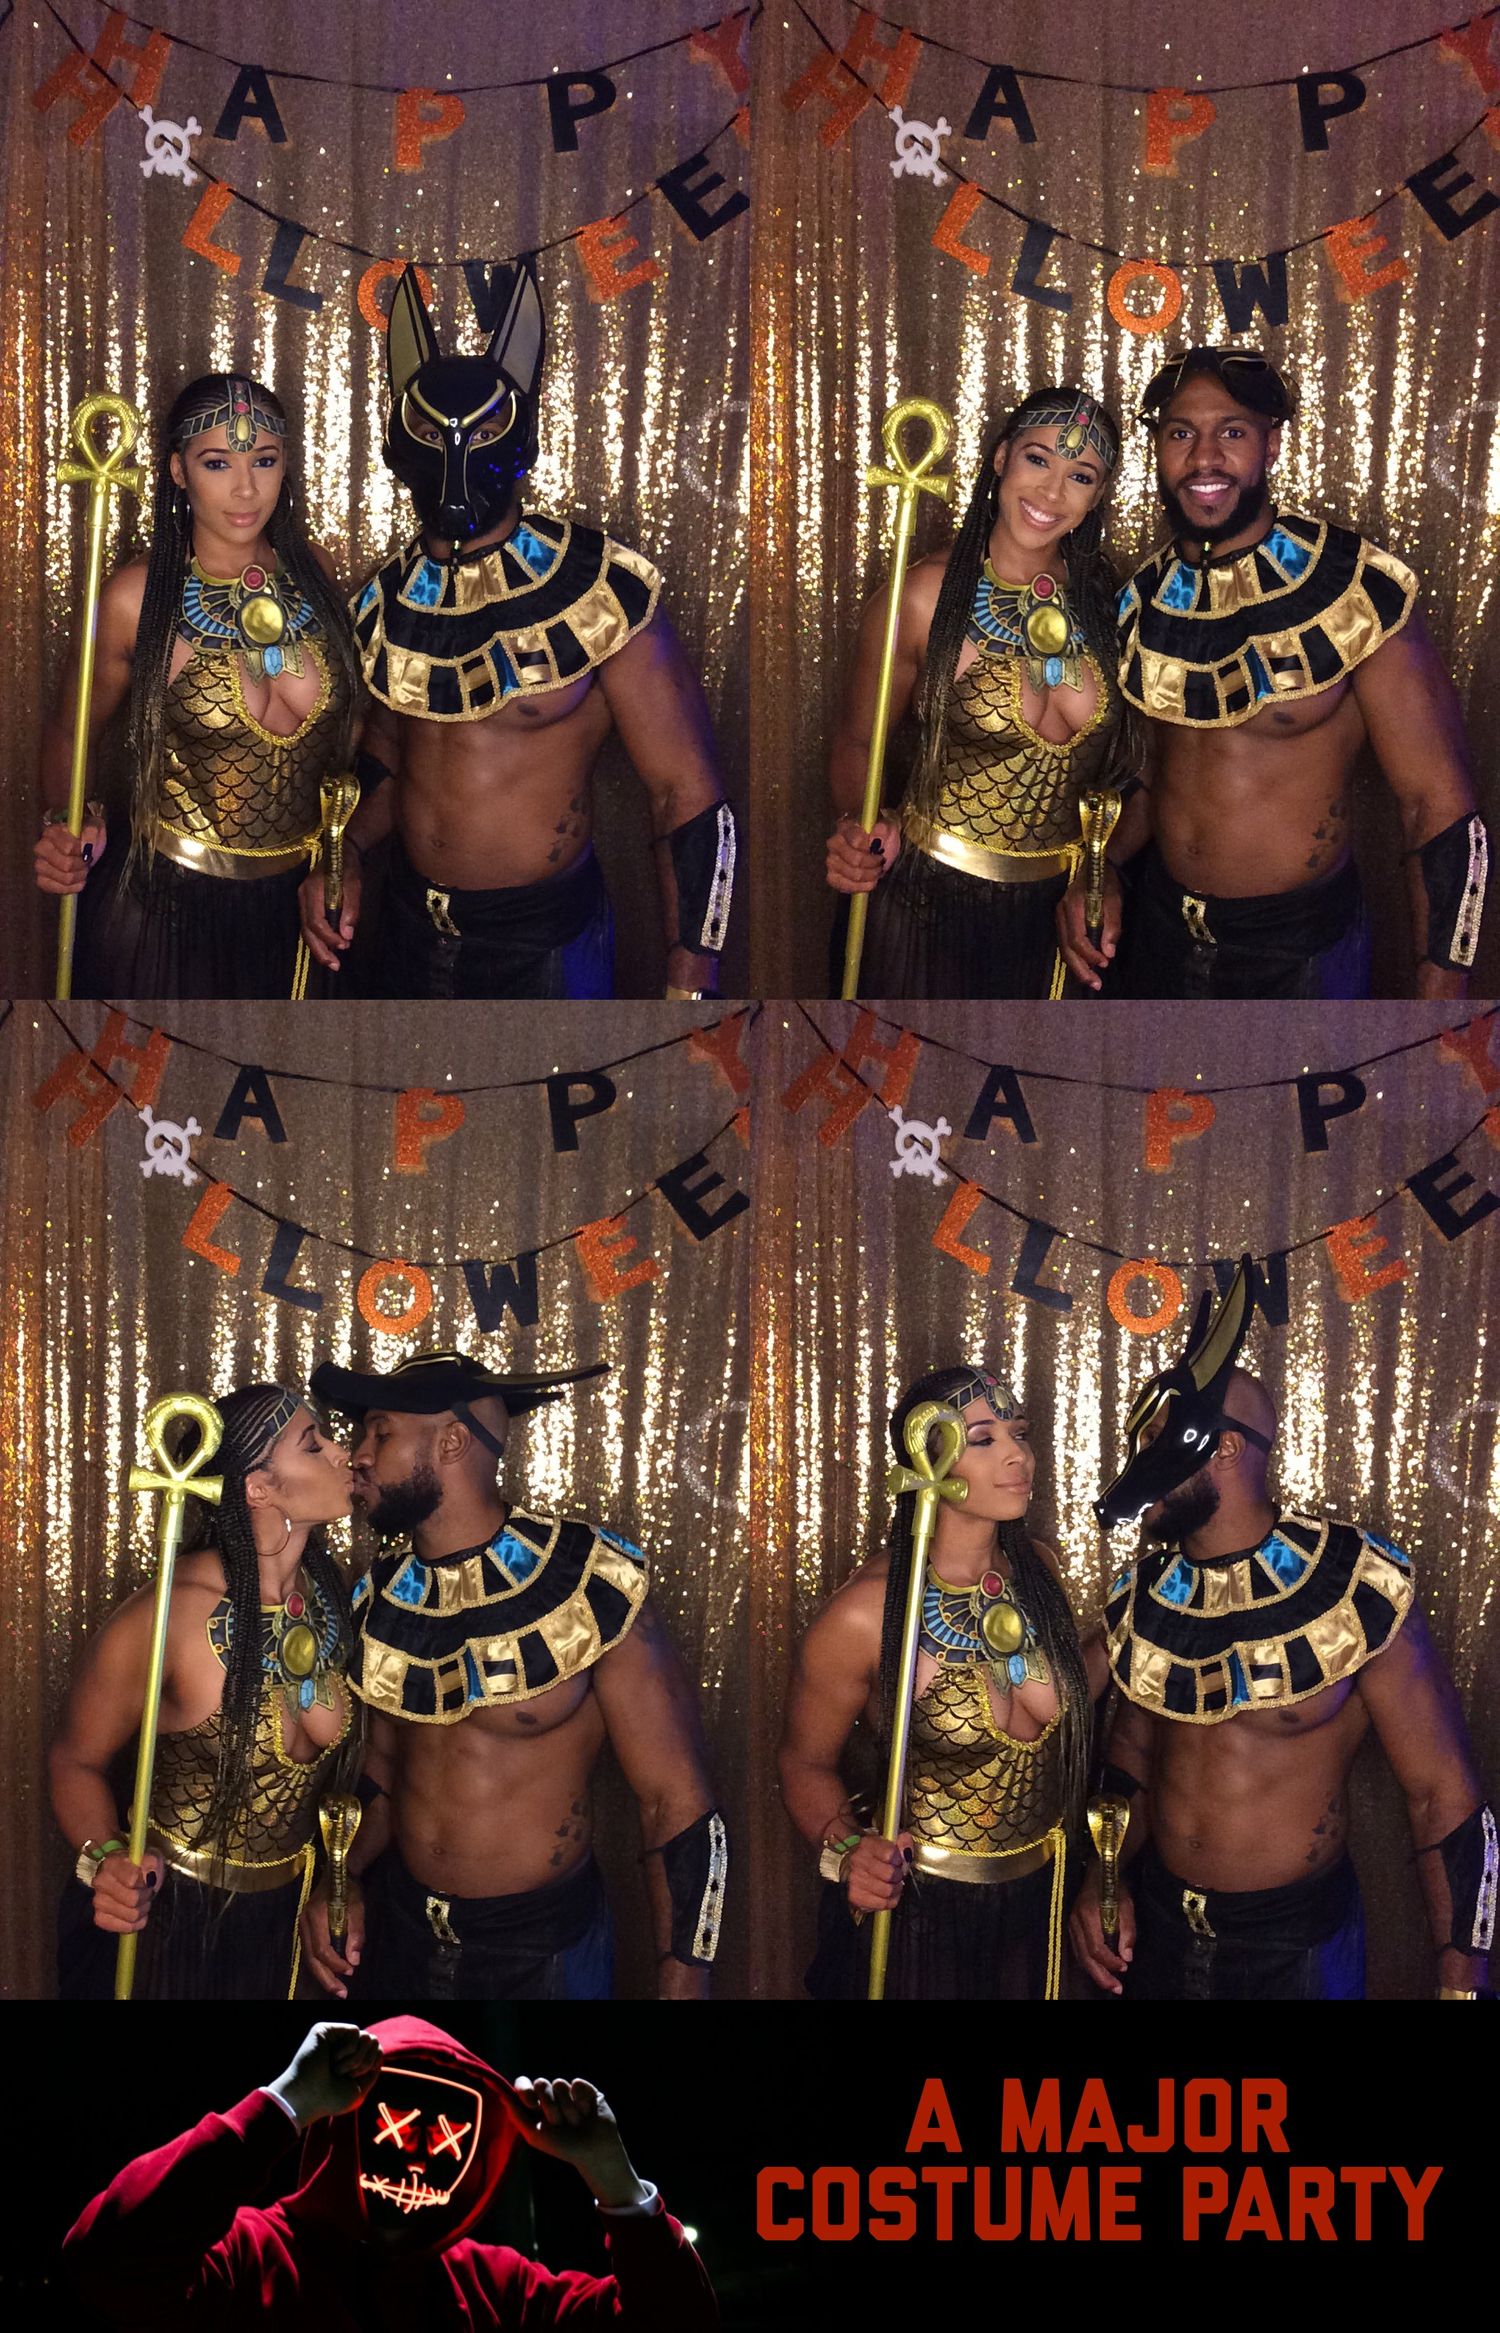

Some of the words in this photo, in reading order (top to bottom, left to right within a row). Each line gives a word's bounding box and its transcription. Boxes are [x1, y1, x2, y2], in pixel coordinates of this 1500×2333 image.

[84, 10, 749, 167] HAPPY
[834, 10, 1500, 167] HAPPY
[84, 1010, 749, 1167] HAPPY
[834, 1010, 1500, 1167] HAPPY
